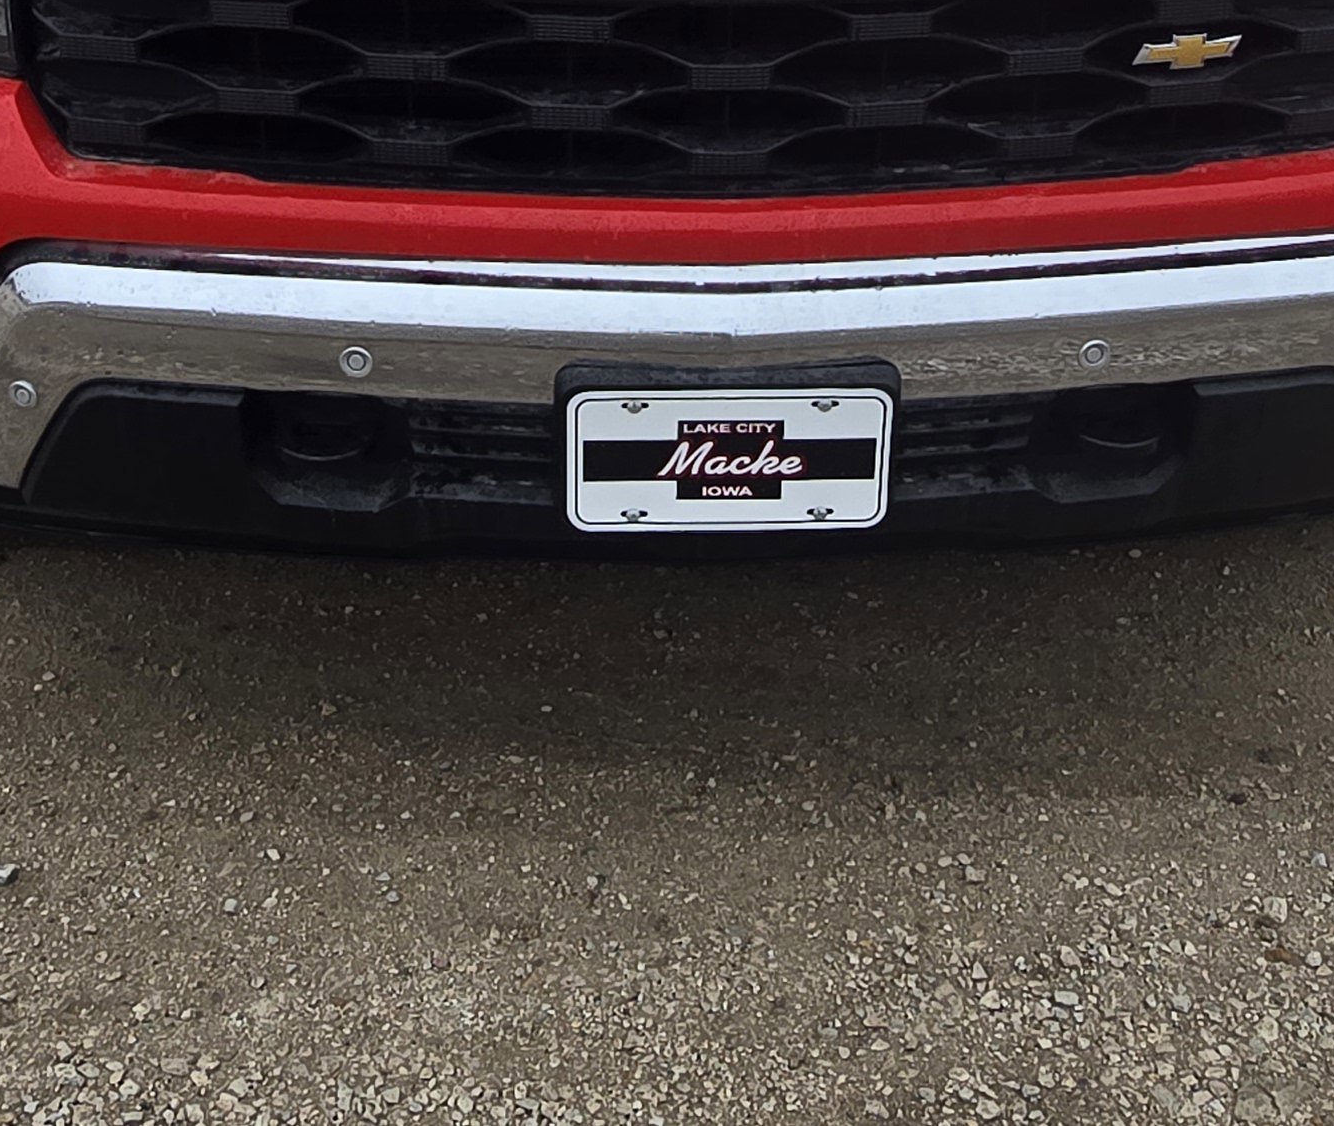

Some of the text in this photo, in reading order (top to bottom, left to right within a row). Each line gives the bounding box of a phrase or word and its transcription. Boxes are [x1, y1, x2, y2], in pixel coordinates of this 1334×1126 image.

[683, 422, 777, 434] LAKE CITY
[657, 440, 803, 477] Macke
[701, 485, 753, 497] IOWA
